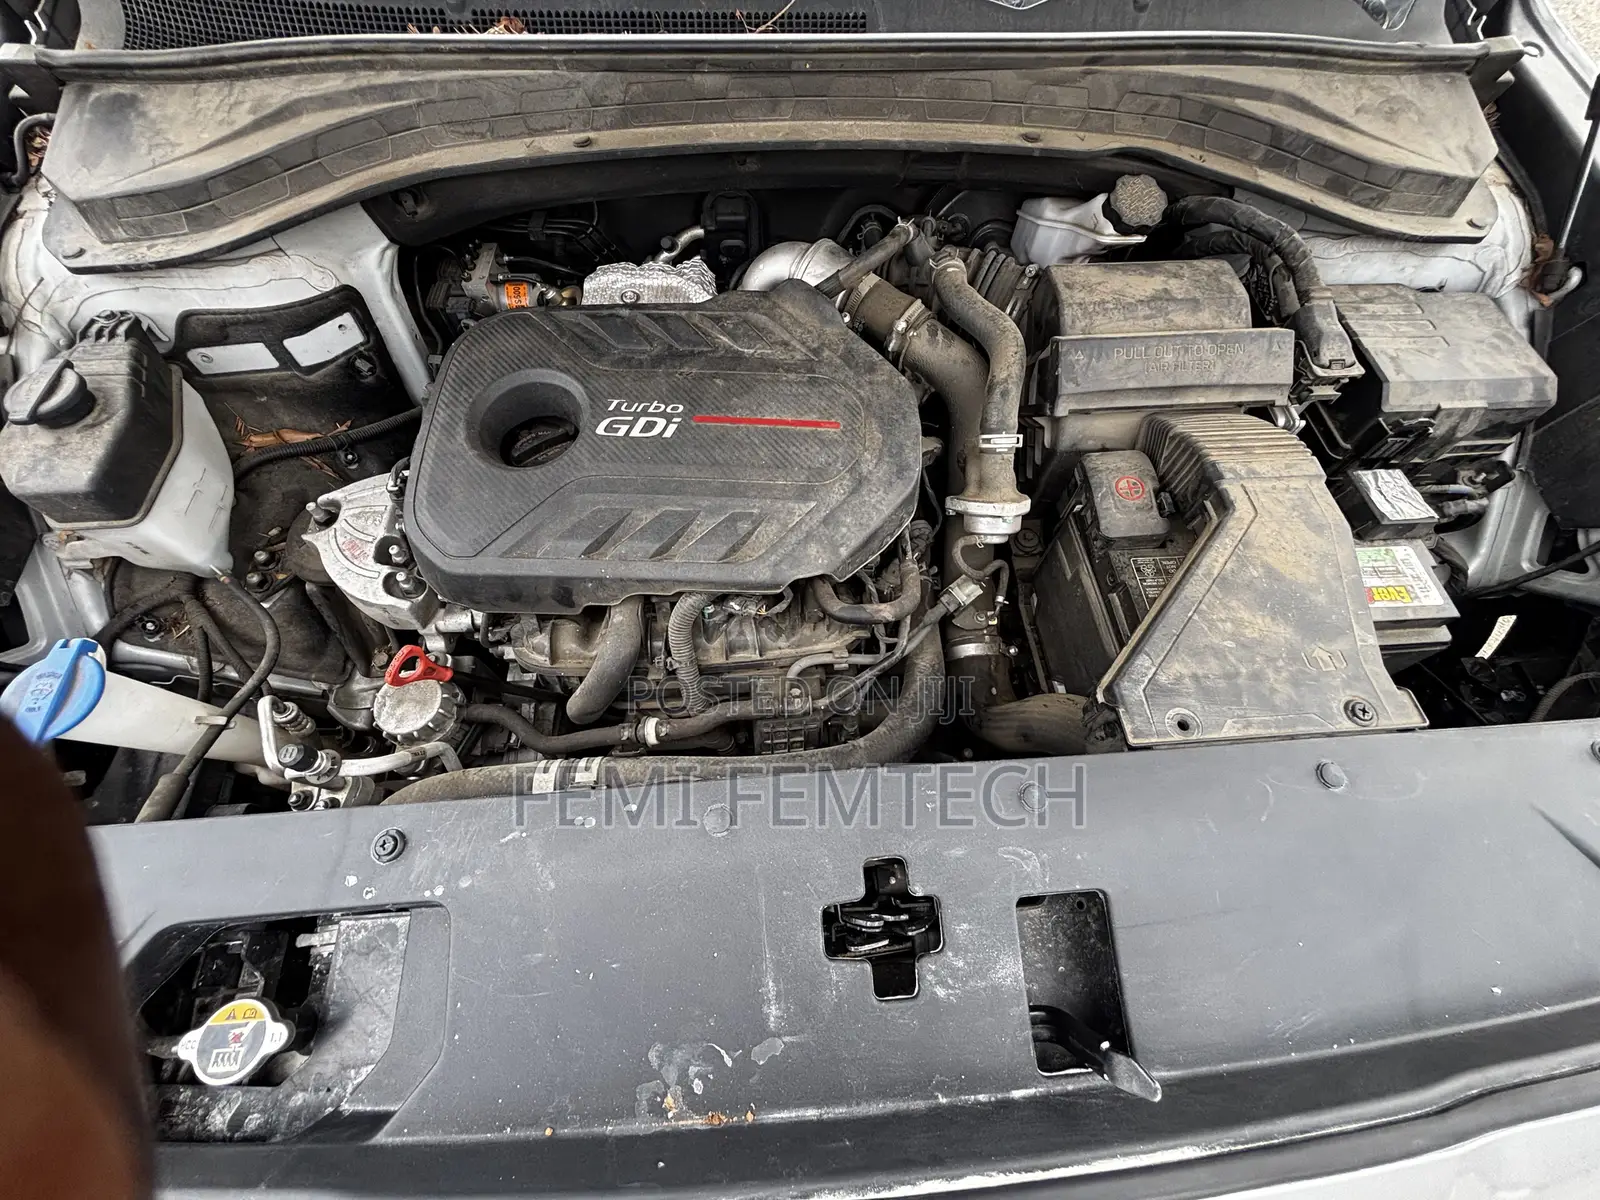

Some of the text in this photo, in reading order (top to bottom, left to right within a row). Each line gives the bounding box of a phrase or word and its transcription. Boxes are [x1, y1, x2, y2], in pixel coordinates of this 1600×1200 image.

[1114, 343, 1244, 360] PULL OUT TO OPEN
[607, 399, 684, 413] Turbo
[595, 416, 683, 438] GDi
